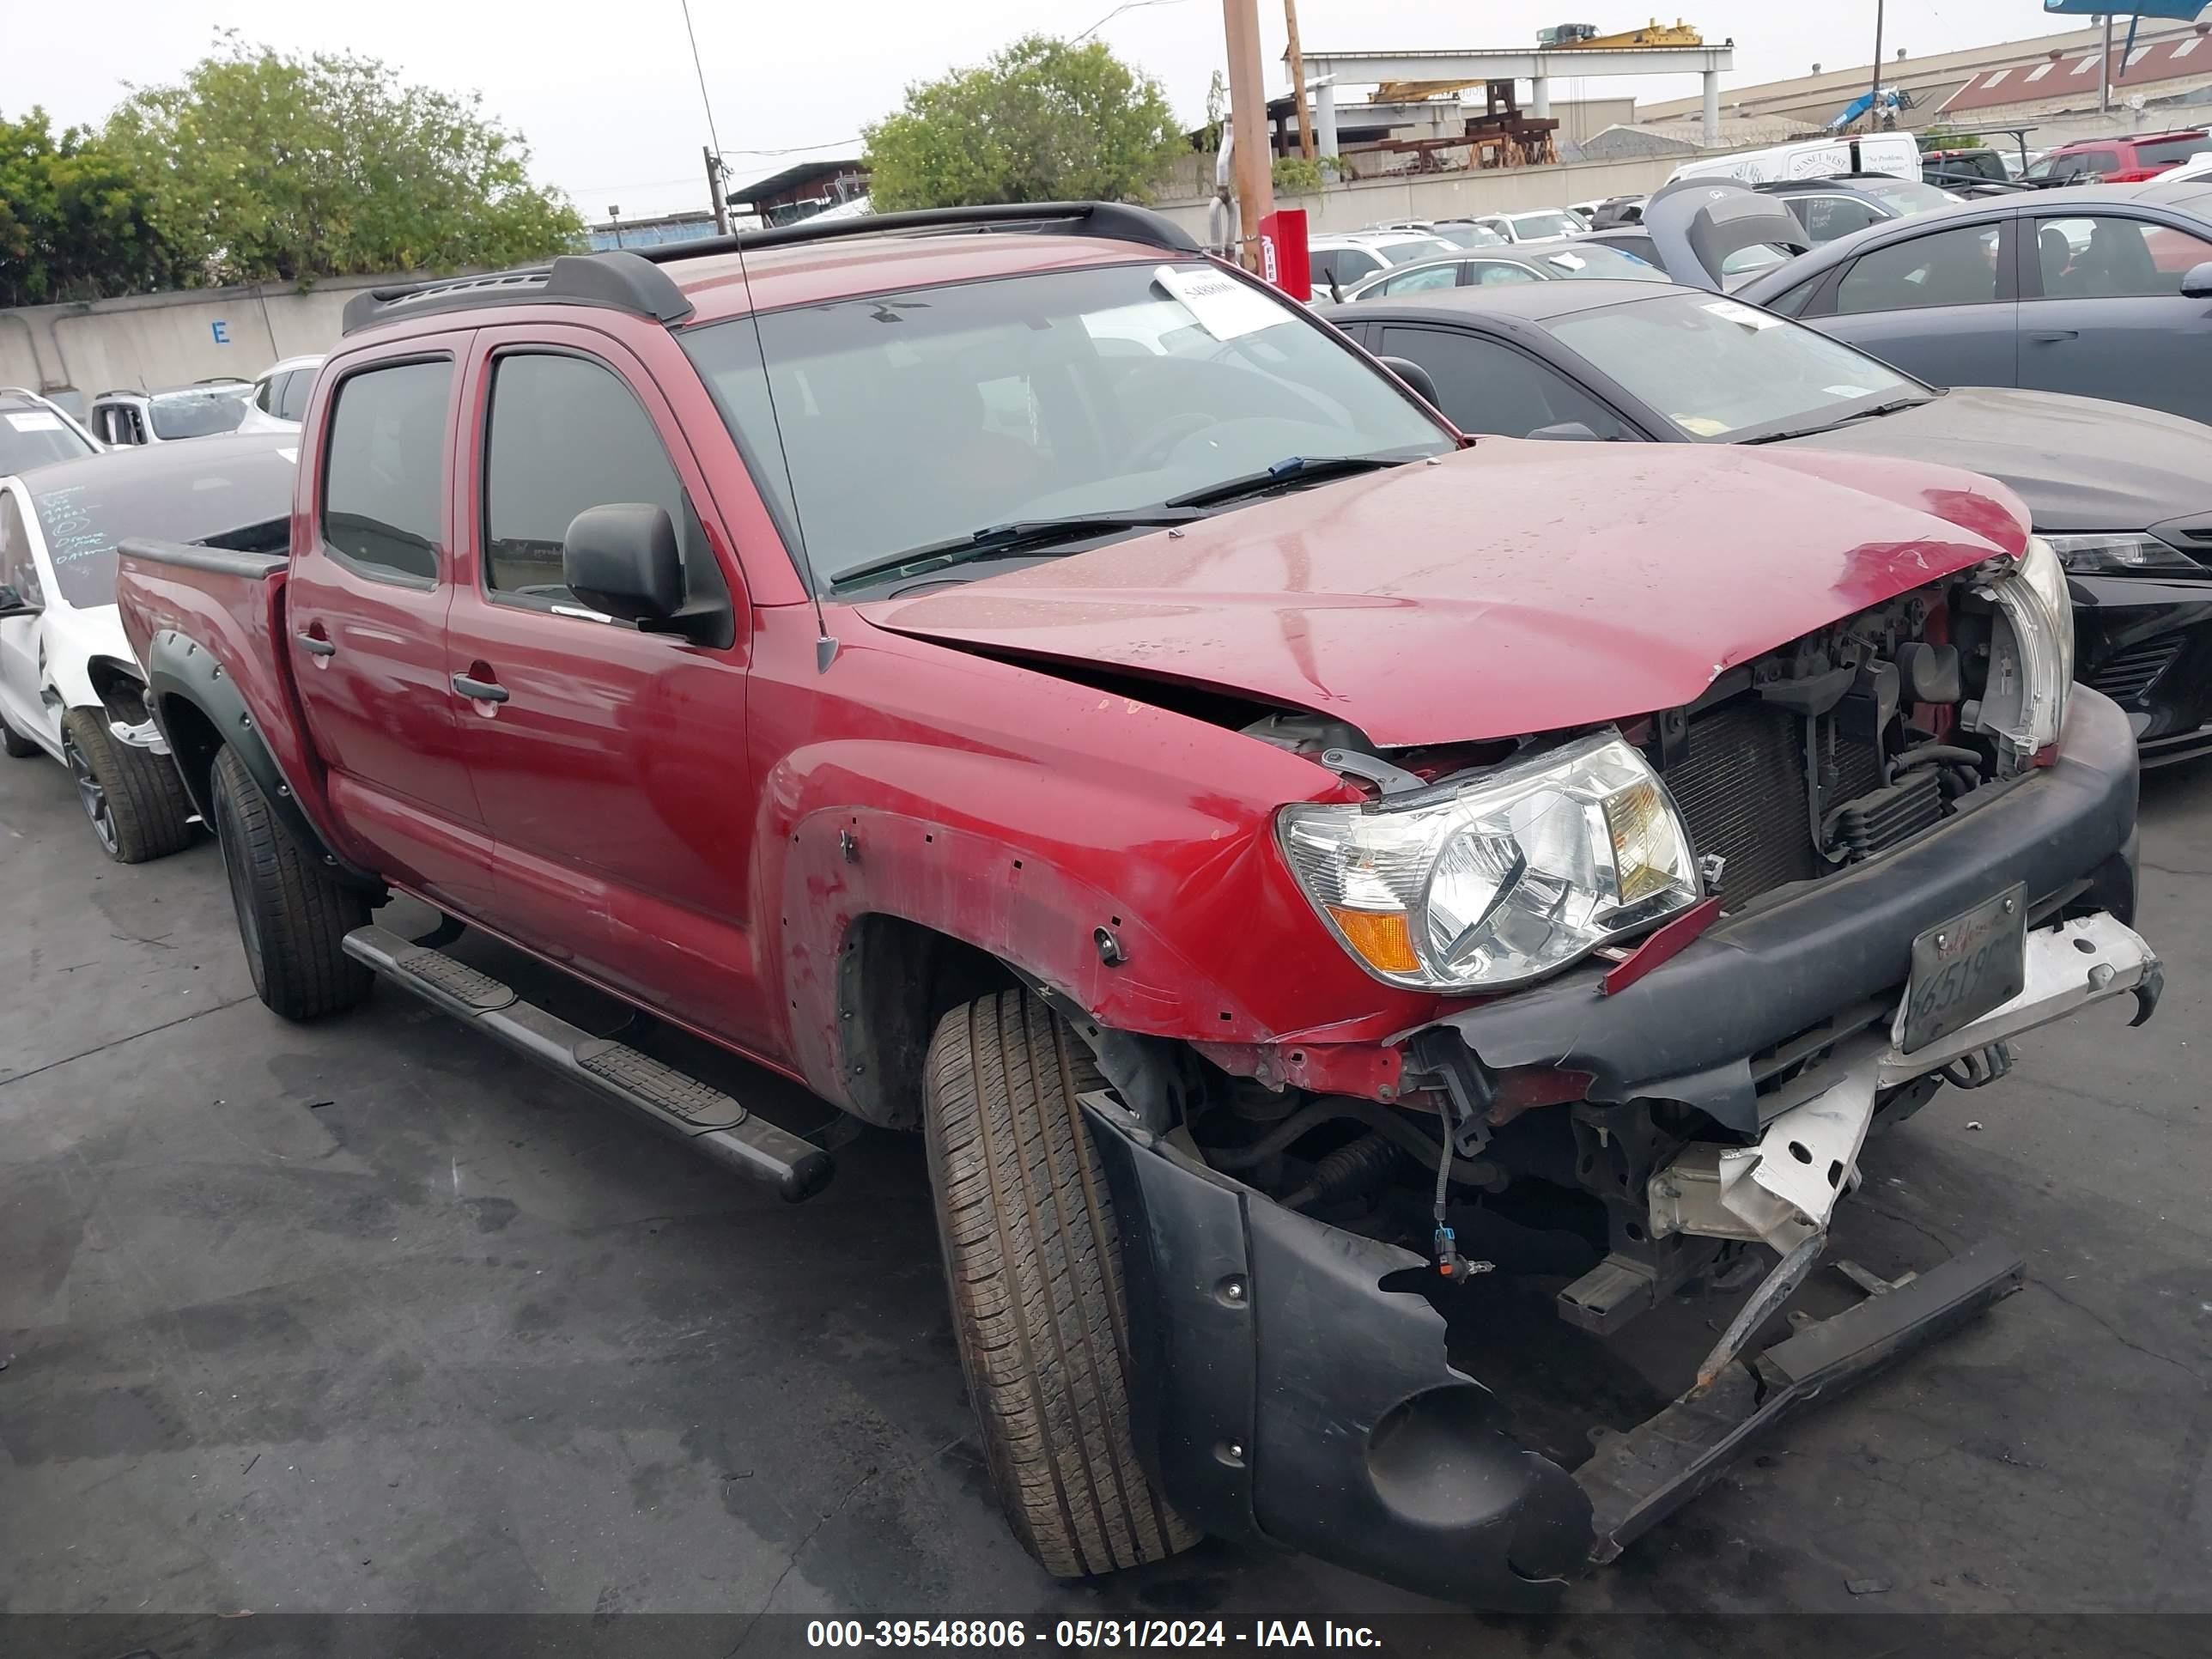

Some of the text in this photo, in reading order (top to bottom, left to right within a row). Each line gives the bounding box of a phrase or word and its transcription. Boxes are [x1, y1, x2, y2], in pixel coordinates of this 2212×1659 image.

[1826, 153, 1847, 168] WEST
[1266, 247, 1275, 279] FIRE
[211, 321, 230, 343] E
